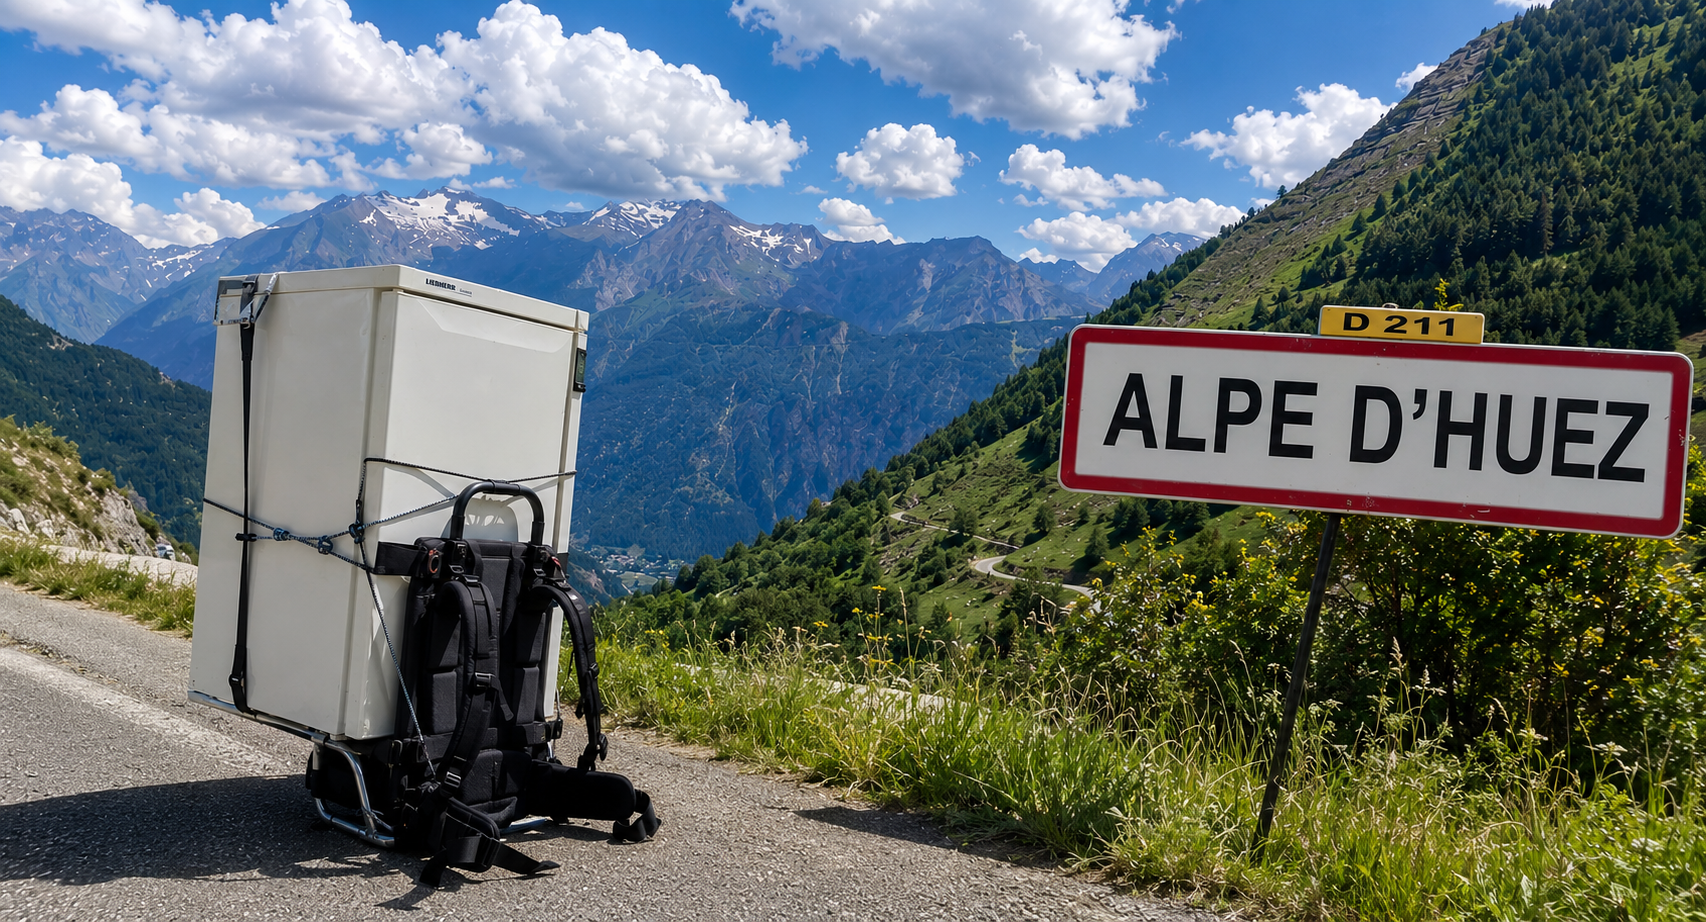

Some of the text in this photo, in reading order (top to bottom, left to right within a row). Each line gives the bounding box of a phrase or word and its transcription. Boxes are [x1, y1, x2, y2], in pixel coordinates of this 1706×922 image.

[1342, 312, 1455, 337] D 211
[1103, 373, 1649, 482] ALPE D’HUEZ
